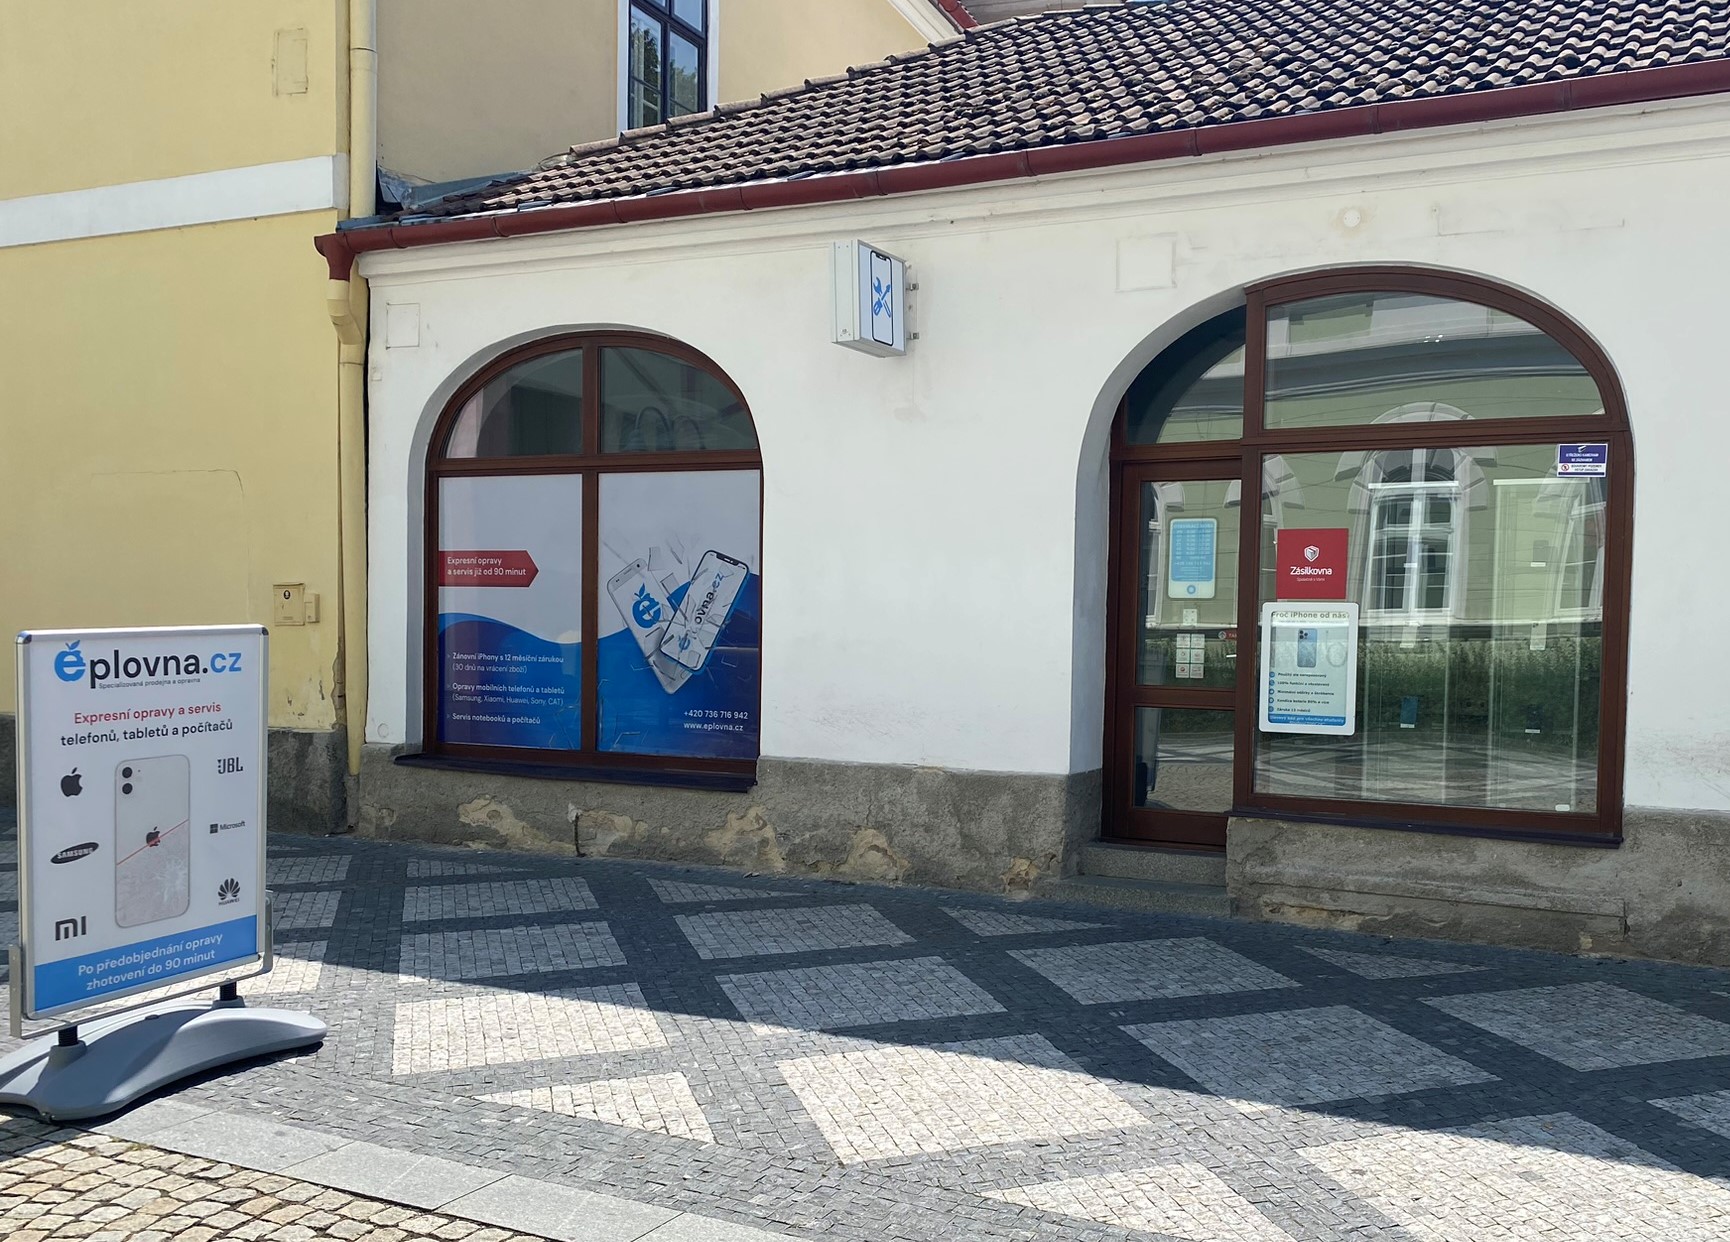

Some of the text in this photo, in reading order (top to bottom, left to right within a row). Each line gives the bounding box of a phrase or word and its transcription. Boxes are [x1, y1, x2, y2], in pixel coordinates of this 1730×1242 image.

[447, 556, 502, 566] Expresní opravy
[474, 568, 482, 577] již
[1290, 566, 1333, 575] Zásilkovna
[452, 663, 463, 671] (30
[452, 683, 475, 691] Opravy
[476, 684, 507, 692] mobilních
[508, 685, 534, 693] telefonů
[541, 686, 565, 694] tabletů
[74, 702, 221, 726] Expresní opravy a servis
[452, 713, 471, 721] Servis
[472, 714, 506, 722] notebooků
[684, 710, 703, 718] +420
[719, 711, 732, 719] 716
[684, 722, 743, 732] www.eplovna.cz
[61, 719, 233, 746] telefonů, tabletů a počítačů
[219, 820, 246, 831] Microsoft
[56, 846, 94, 860] SAMSUNG
[78, 933, 224, 977] Po předobjednání opravy
[86, 950, 215, 991] zhotovení do 90 minut
